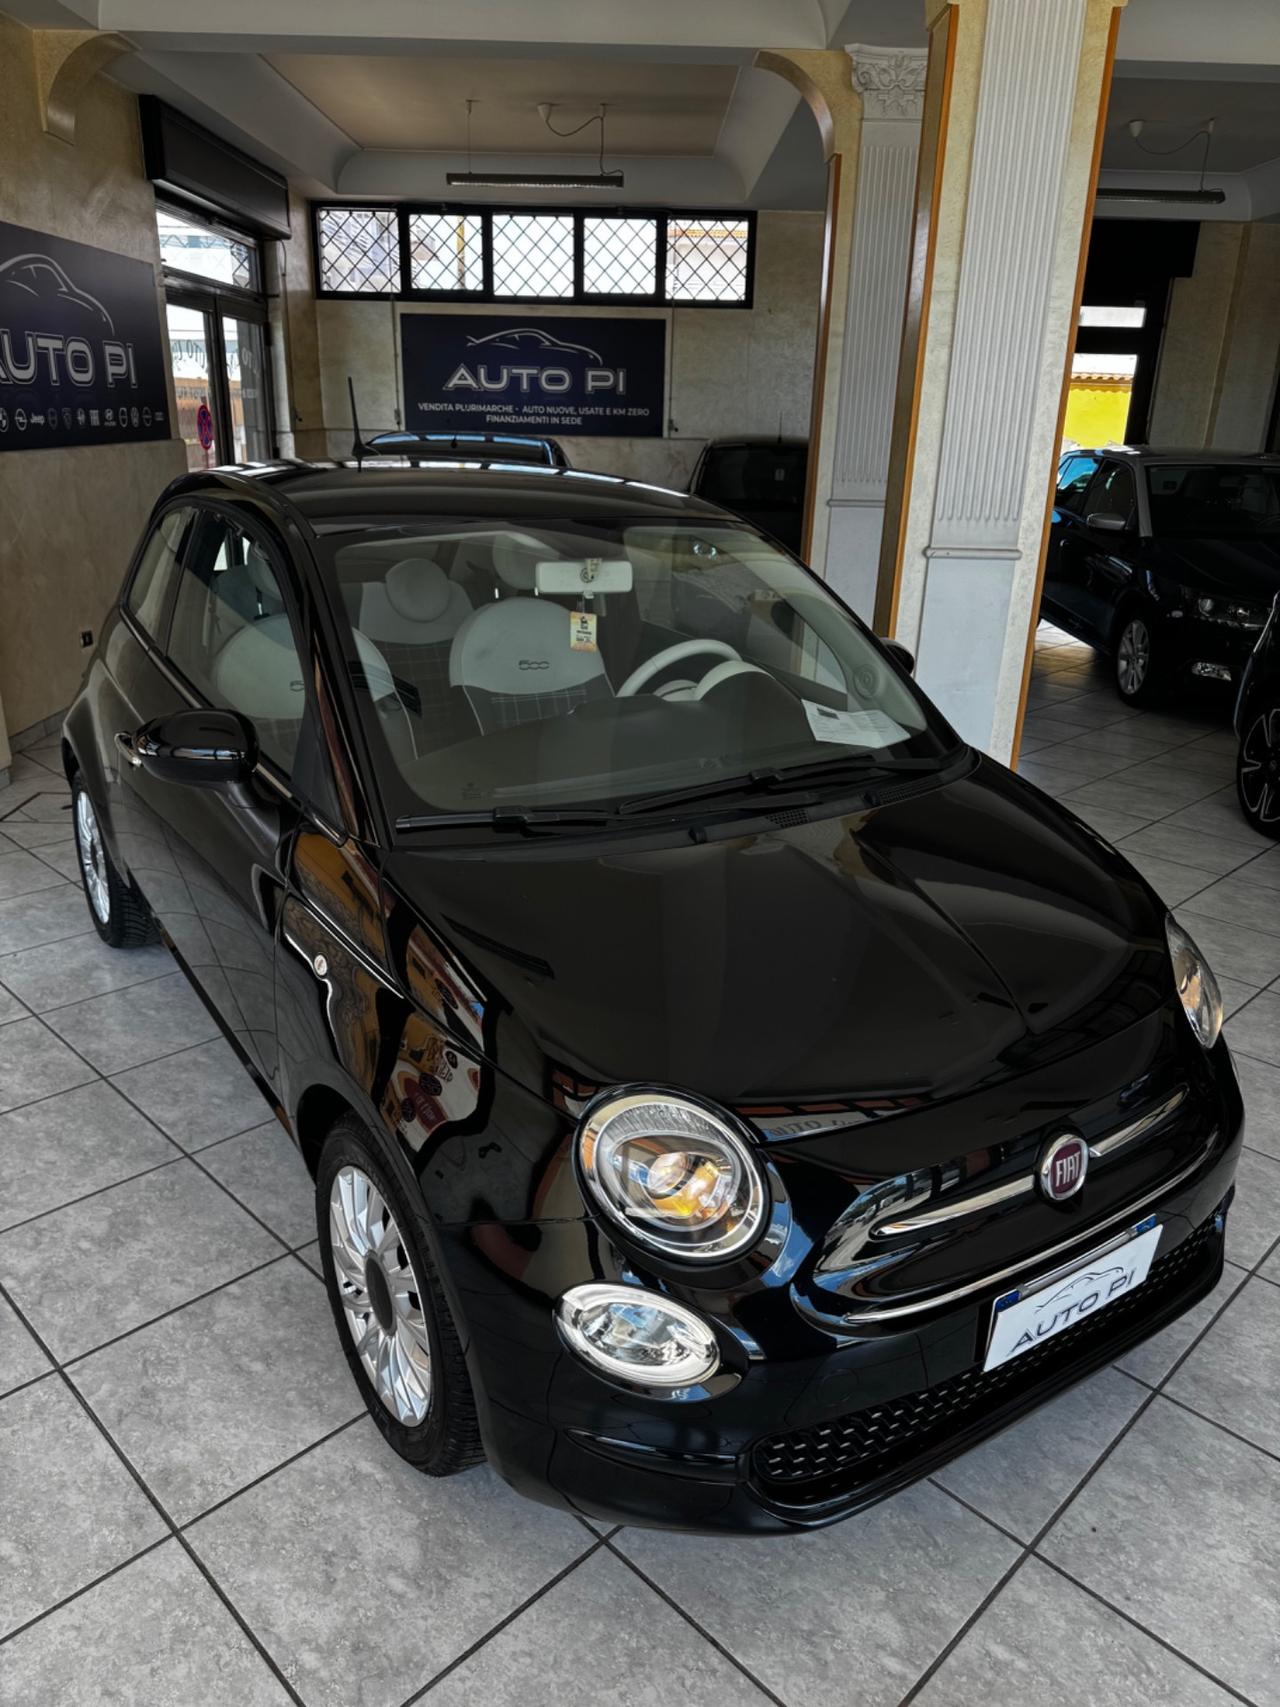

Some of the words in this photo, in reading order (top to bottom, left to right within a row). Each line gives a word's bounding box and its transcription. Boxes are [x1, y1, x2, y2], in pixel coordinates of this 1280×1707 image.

[0, 328, 95, 387] UTO
[102, 340, 138, 389] PI
[442, 363, 572, 394] AUTO
[585, 367, 627, 394] PI
[418, 402, 454, 412] VENDITA
[455, 403, 514, 414] PLURIMARCHE
[522, 405, 545, 414] AUTO
[546, 406, 577, 415] NUOVE,
[578, 407, 604, 416] USATE
[606, 408, 611, 416] E
[613, 408, 626, 417] KM
[628, 408, 650, 417] ZERO
[486, 415, 550, 425] FINANZIAMENTI
[551, 416, 560, 425] IN
[561, 416, 583, 425] SEDE
[518, 660, 550, 670] 500
[1055, 1152, 1080, 1187] FIAT
[1010, 1292, 1098, 1352] AUTO
[1108, 1269, 1136, 1297] PI
